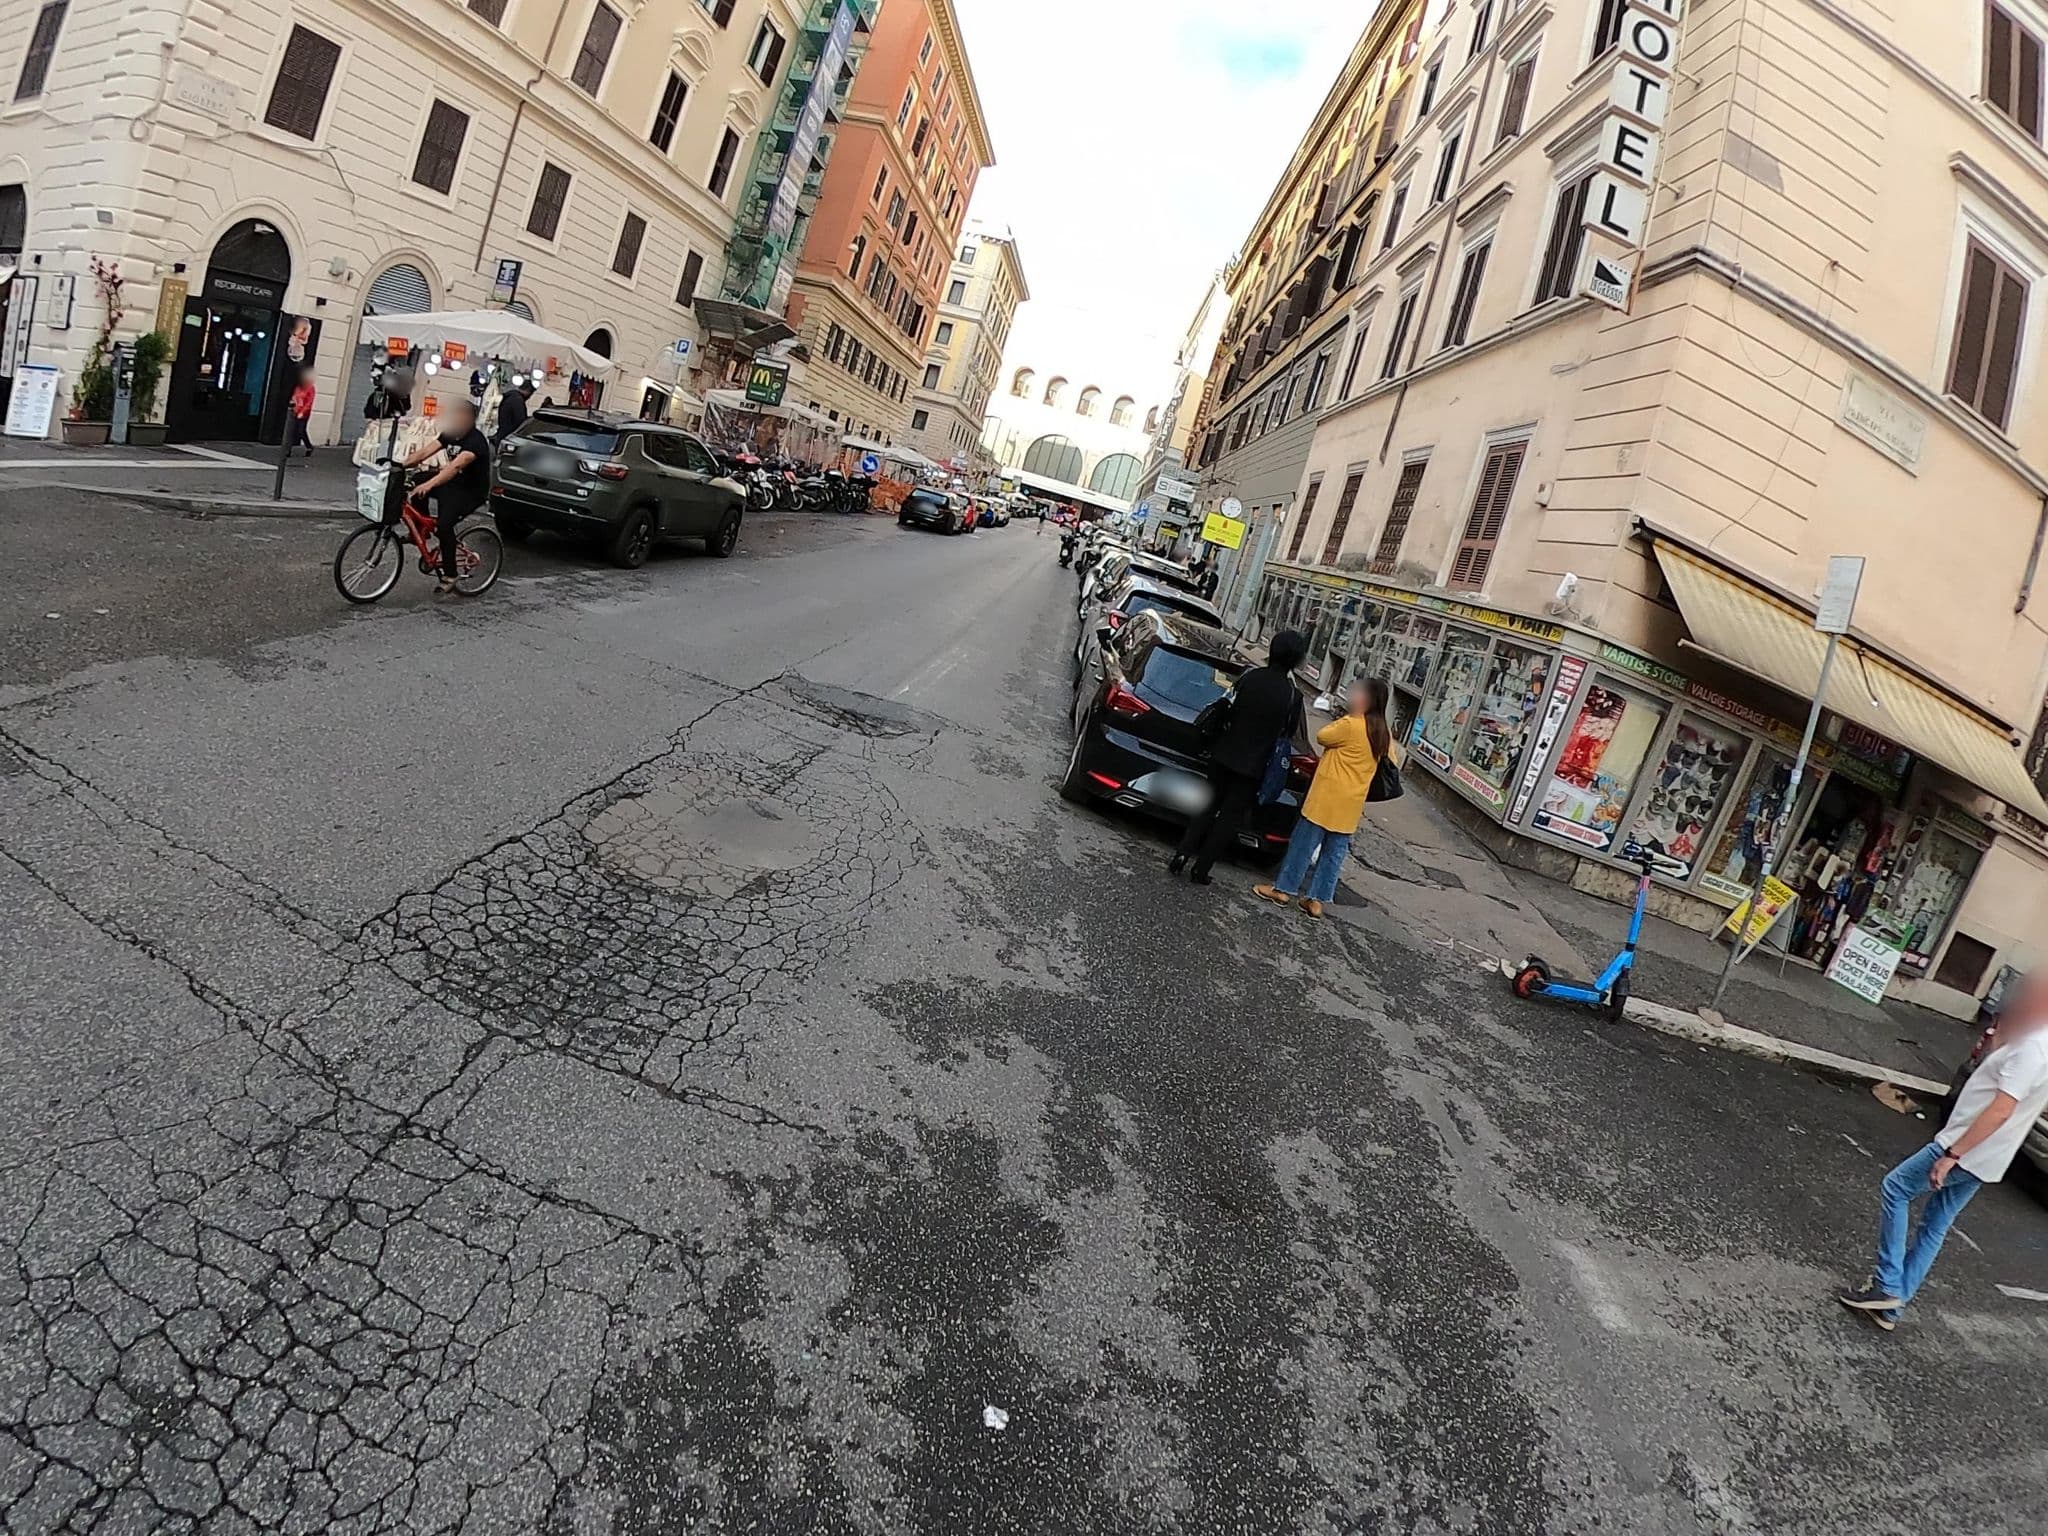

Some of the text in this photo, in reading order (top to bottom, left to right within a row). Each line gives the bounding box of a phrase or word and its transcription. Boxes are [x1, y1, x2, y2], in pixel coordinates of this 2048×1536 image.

[1600, 0, 1672, 237] OTEL
[1602, 644, 1688, 690] VARITISE STORE
[1726, 700, 1766, 726] STORAGE
[1838, 959, 1865, 979] TICKET
[1843, 948, 1869, 968] OPEN
[1869, 962, 1890, 980] BUS
